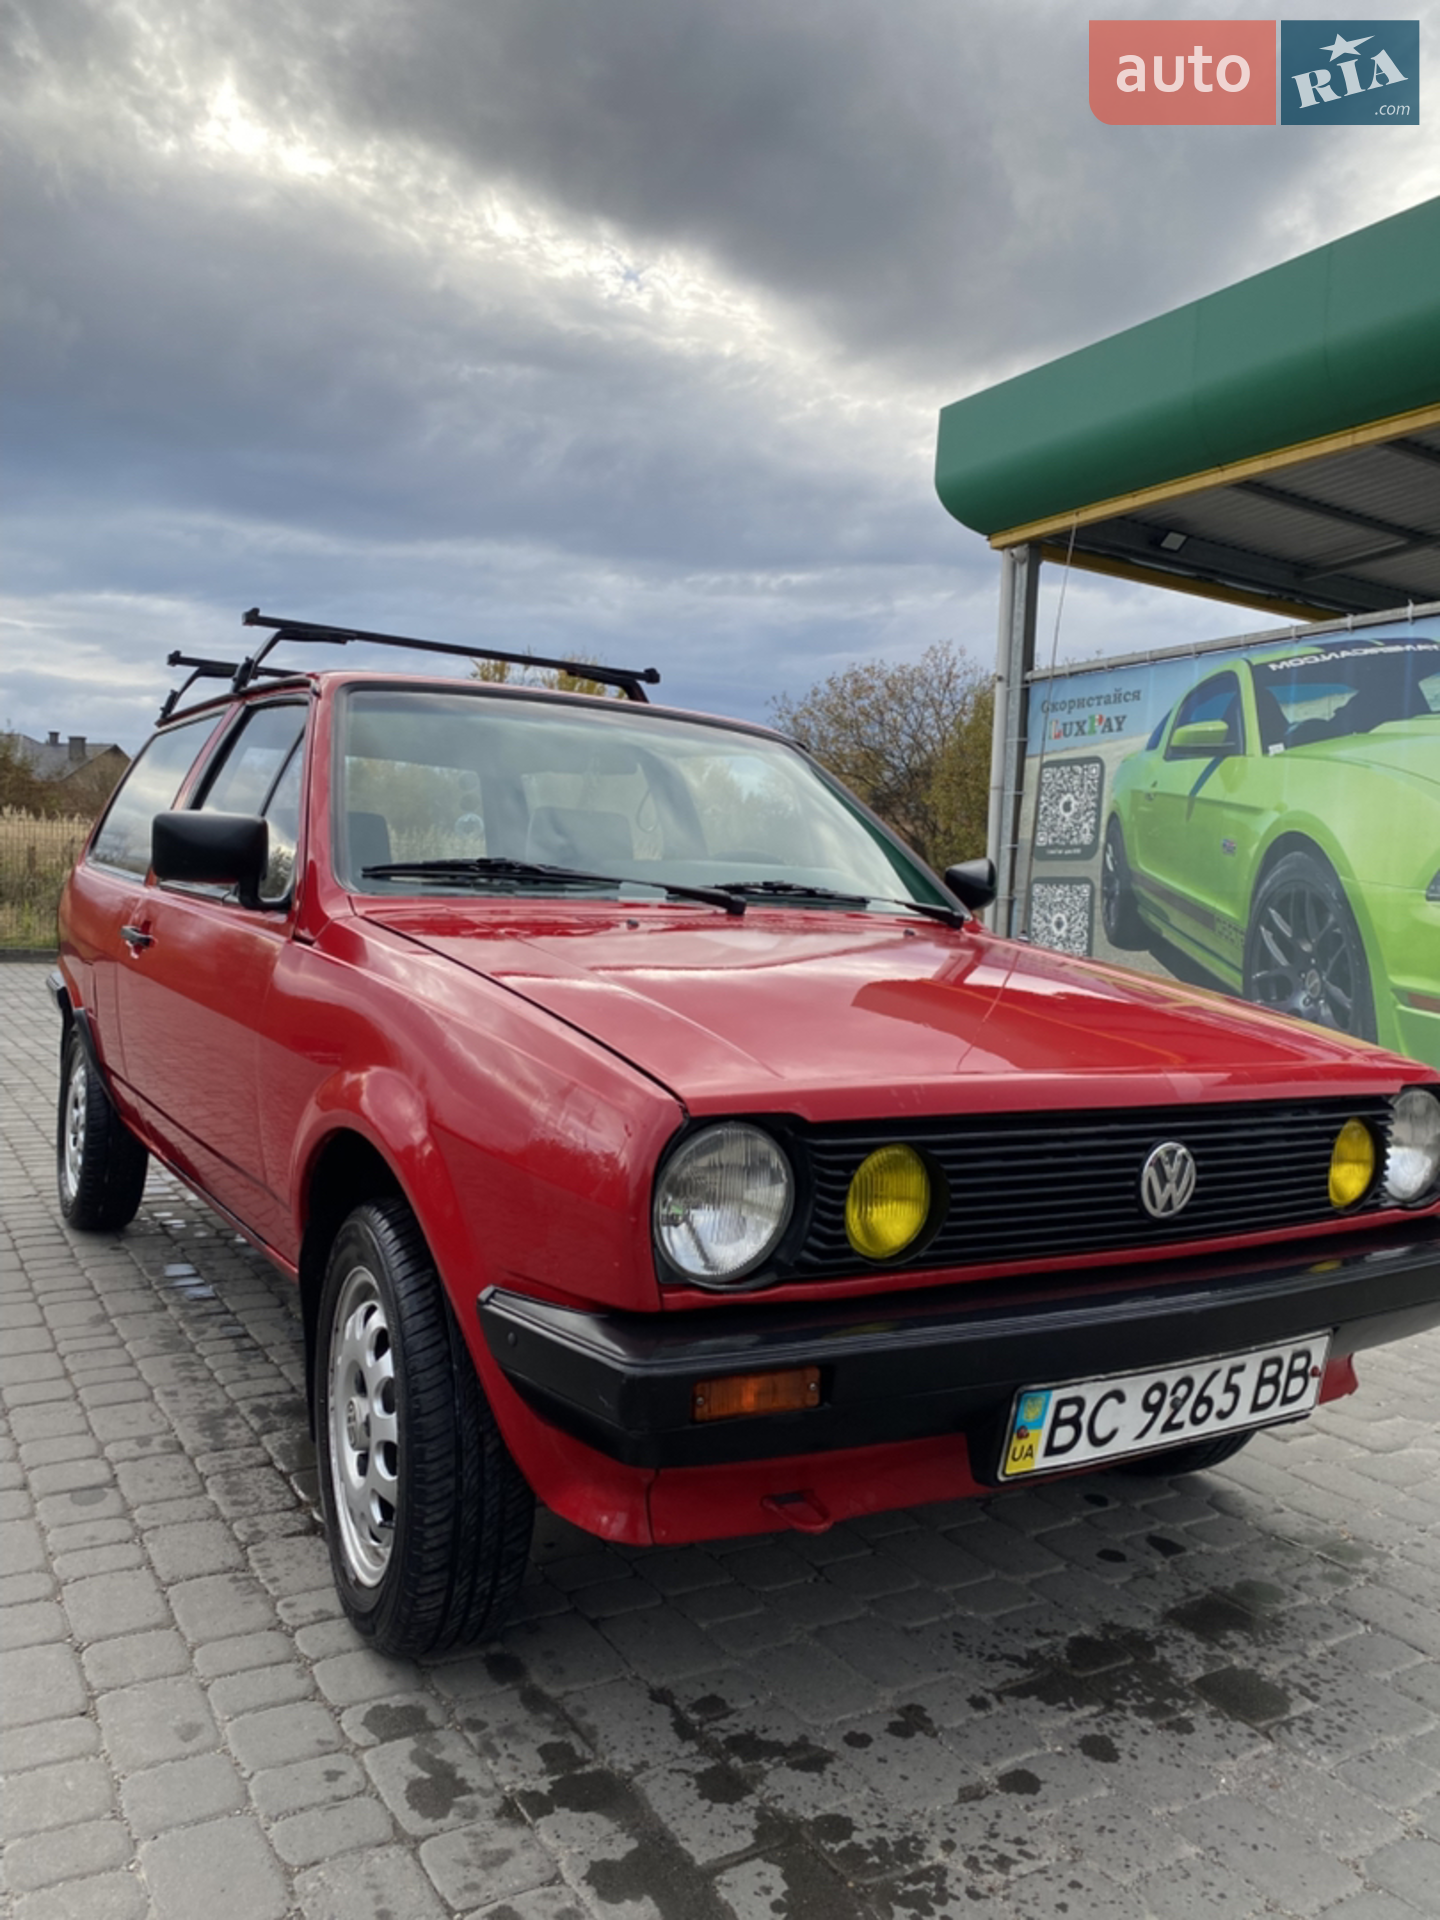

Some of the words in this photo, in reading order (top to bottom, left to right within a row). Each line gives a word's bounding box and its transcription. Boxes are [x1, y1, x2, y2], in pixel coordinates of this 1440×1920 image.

[1041, 688, 1142, 714] Скористайся
[1043, 1389, 1126, 1458] BC
[1134, 1363, 1246, 1440] 9265
[1249, 1349, 1313, 1414] BB
[1011, 1443, 1035, 1462] UA
